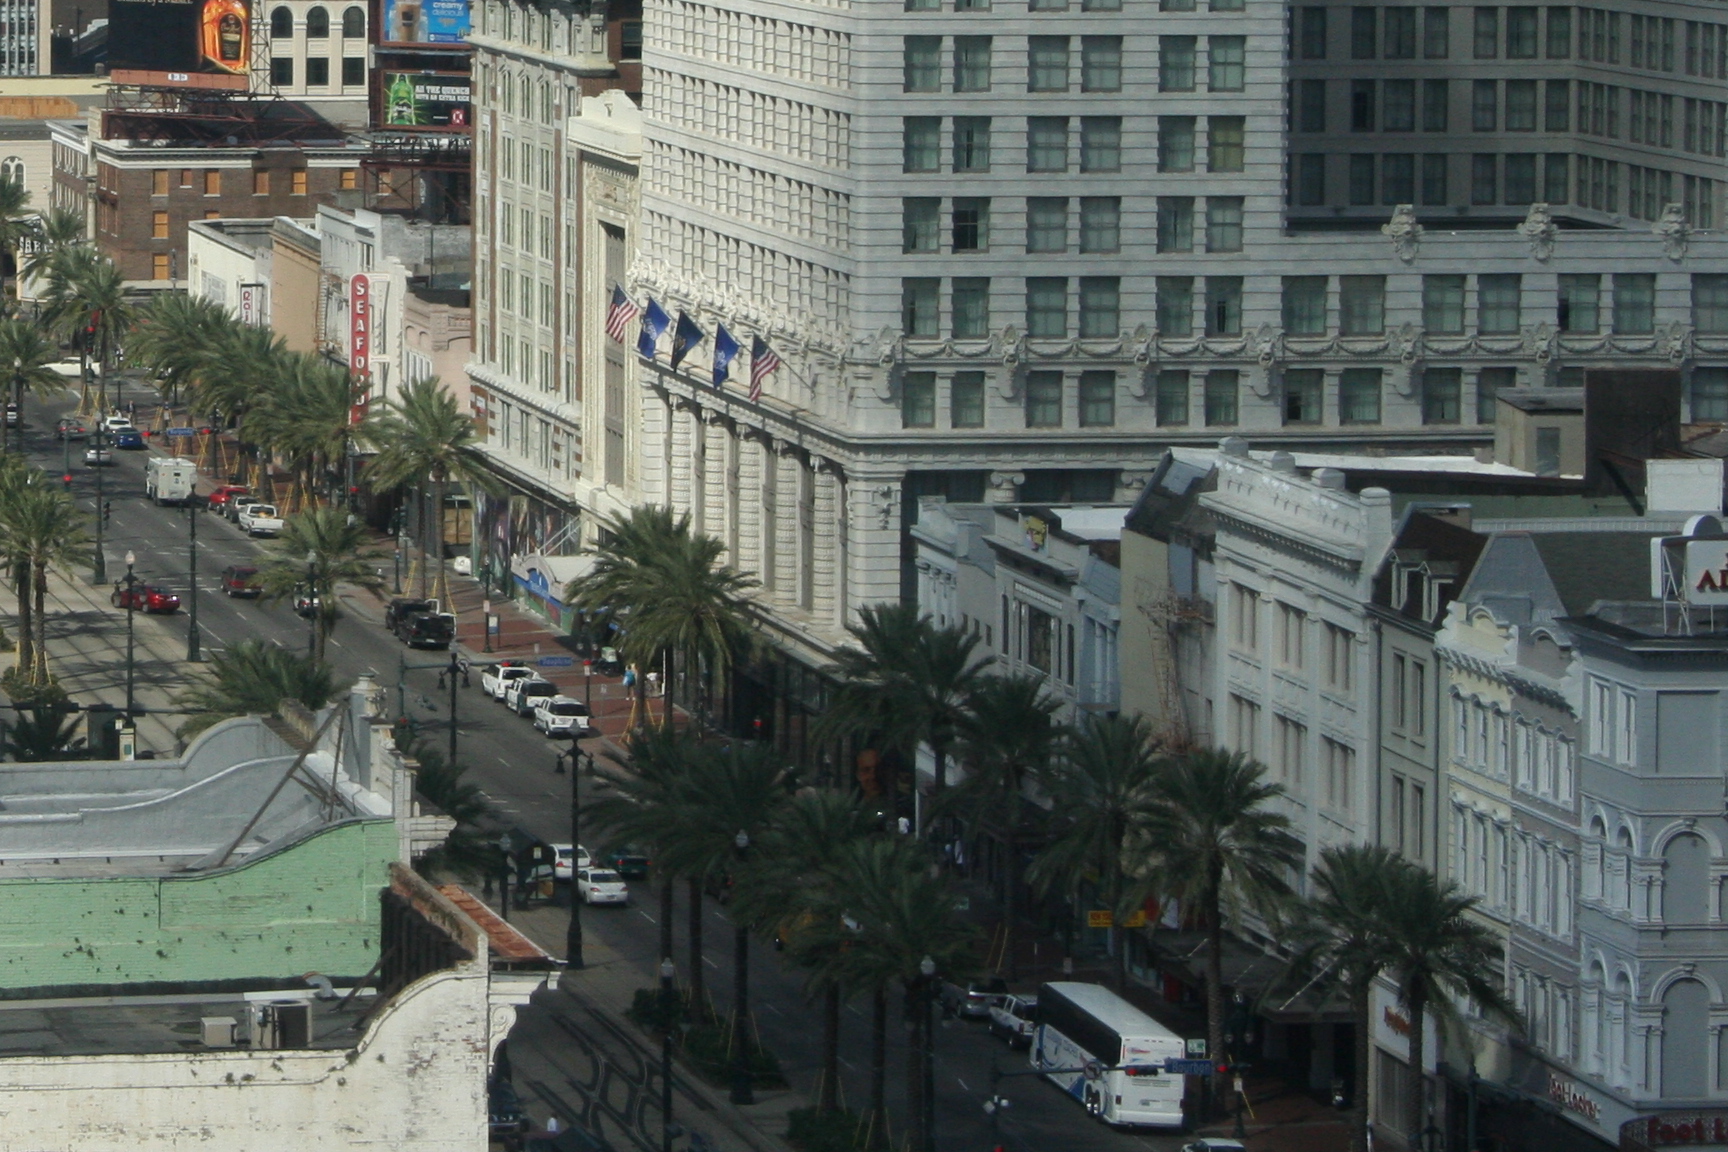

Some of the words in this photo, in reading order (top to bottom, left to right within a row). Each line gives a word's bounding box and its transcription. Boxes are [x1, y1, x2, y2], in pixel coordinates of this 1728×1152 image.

[433, 2, 464, 10] creamy
[1172, 1061, 1211, 1074] Bourbon
[1648, 1117, 1704, 1142] Foot
